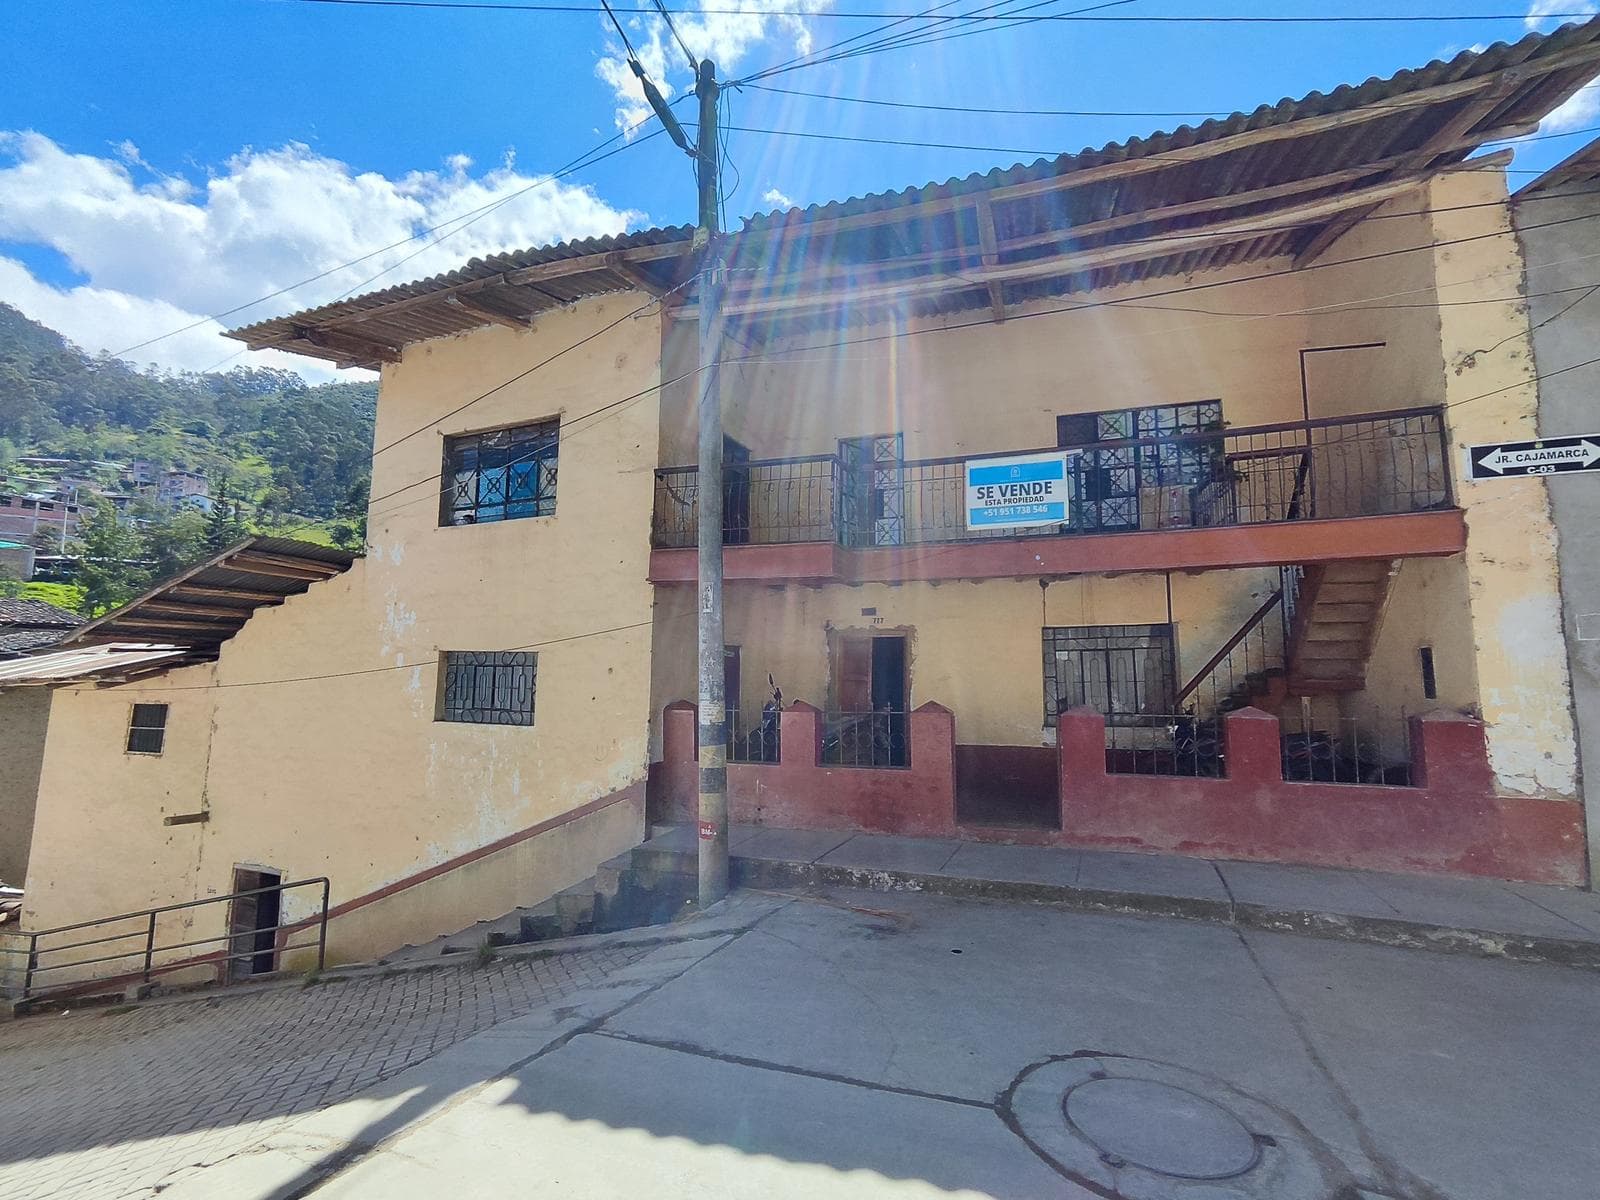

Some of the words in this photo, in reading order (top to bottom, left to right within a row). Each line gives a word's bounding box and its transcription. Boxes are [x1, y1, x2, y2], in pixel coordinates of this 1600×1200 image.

[1495, 455, 1512, 464] JR.
[1516, 449, 1590, 462] CAJAMARCA
[1527, 465, 1556, 474] C-03
[977, 486, 994, 500] SE
[998, 481, 1053, 498] VENDE
[985, 498, 1002, 507] ESTA
[1003, 496, 1044, 505] PROPIEDAD
[983, 508, 998, 517] +51
[999, 507, 1014, 516] 951
